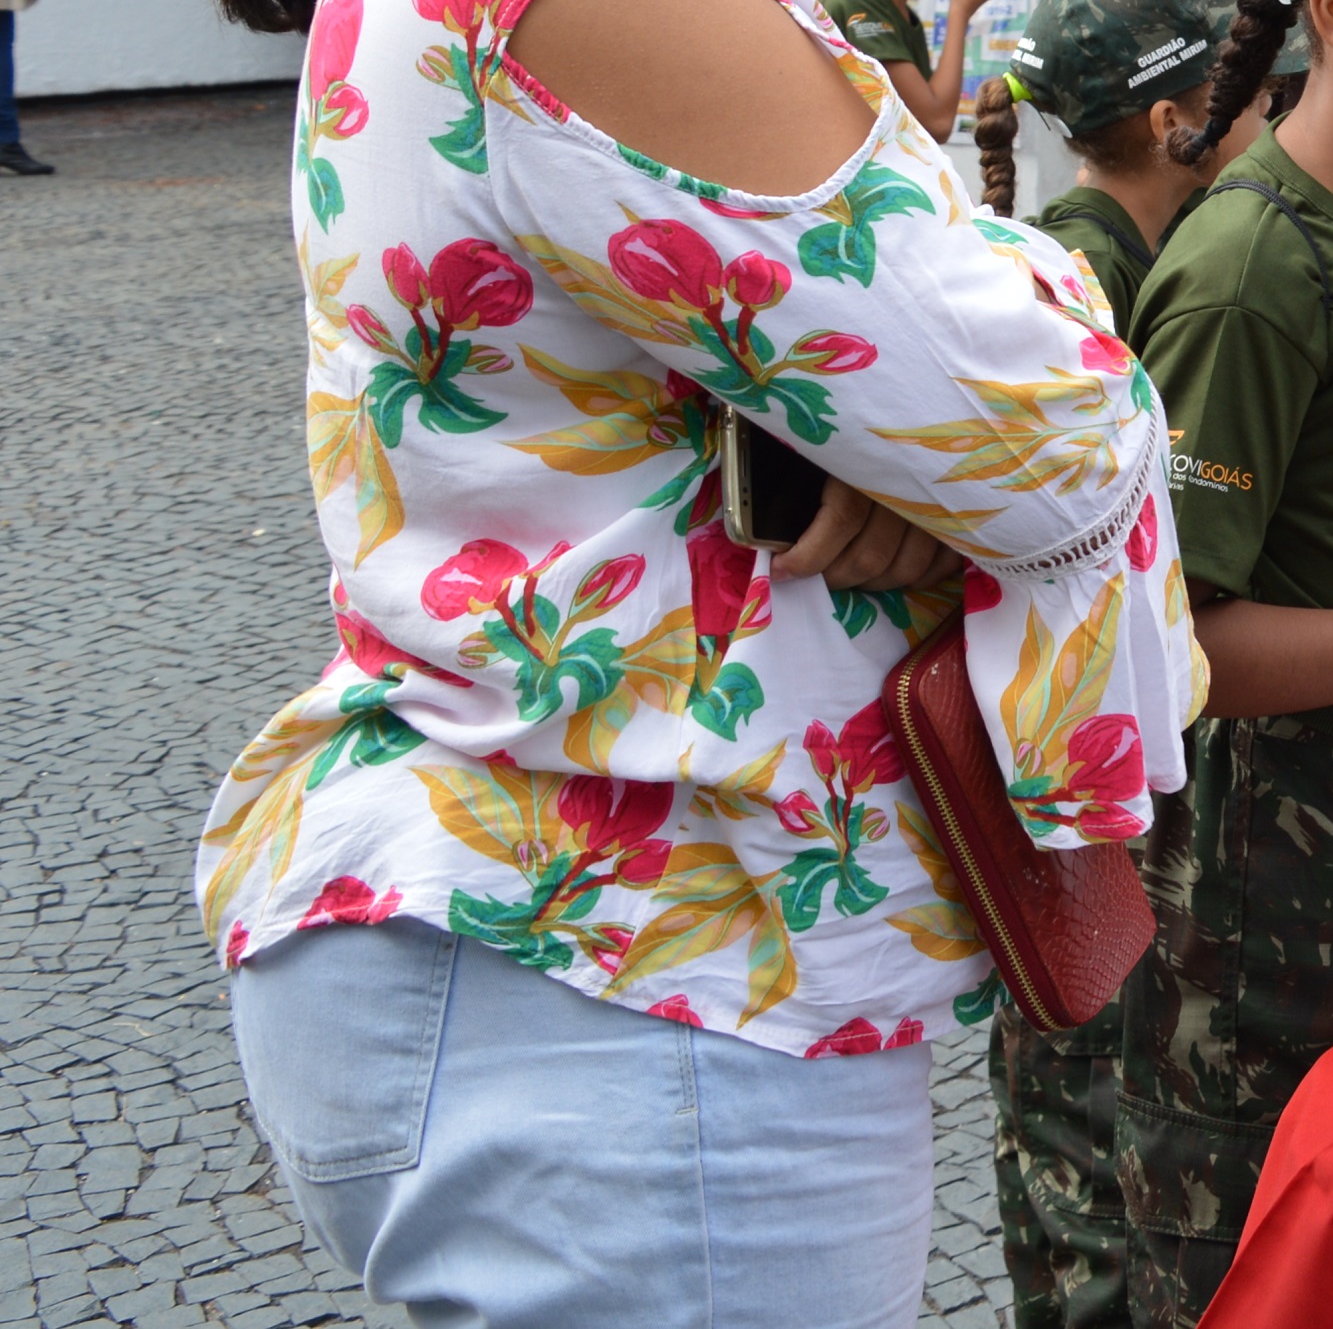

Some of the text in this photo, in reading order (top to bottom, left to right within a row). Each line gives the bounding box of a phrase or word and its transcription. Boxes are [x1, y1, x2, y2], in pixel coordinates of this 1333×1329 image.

[1127, 39, 1208, 89] AMBIENTAL MIRIM
[1137, 37, 1186, 68] GUARDIÃO
